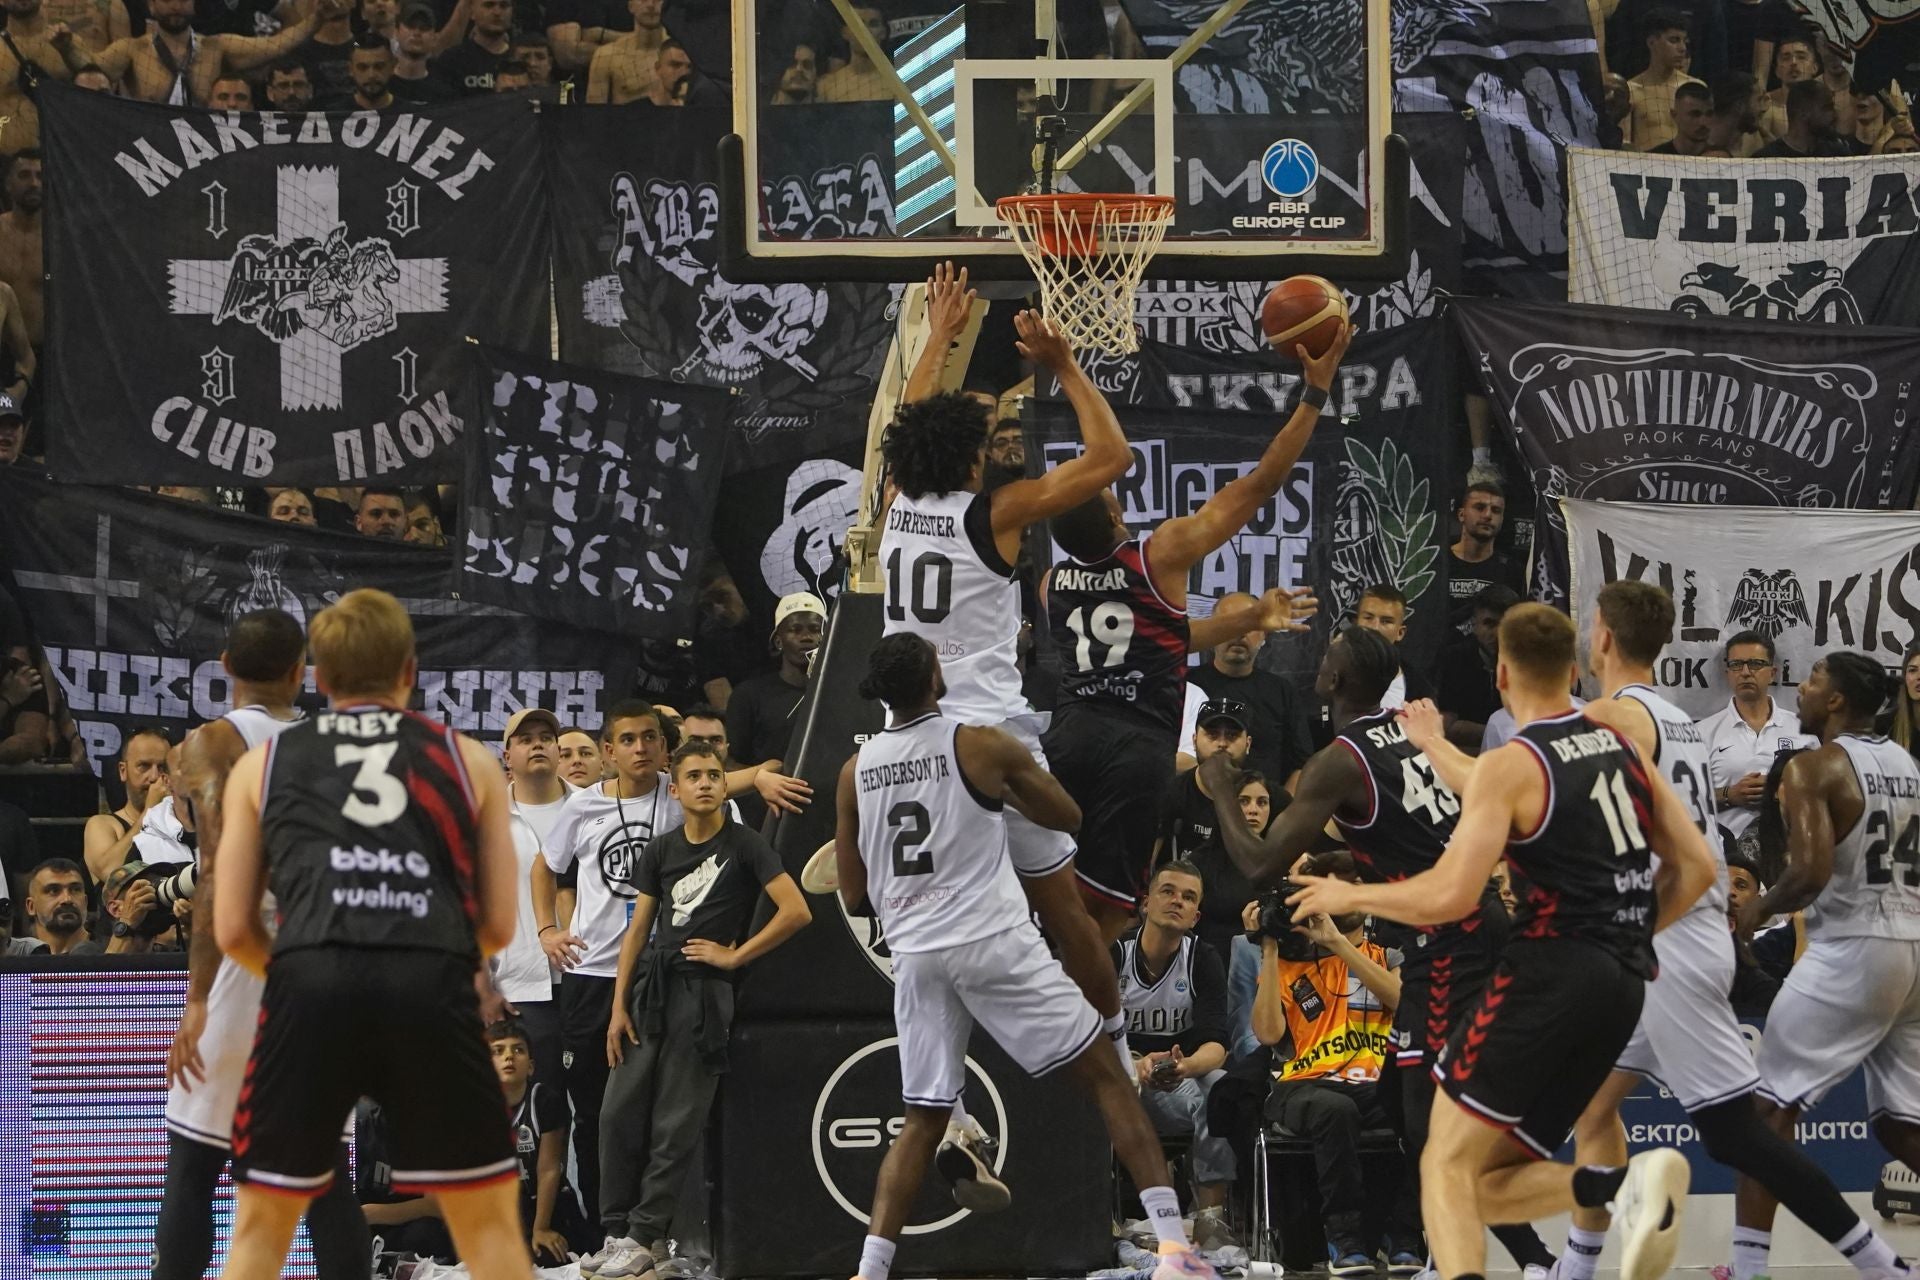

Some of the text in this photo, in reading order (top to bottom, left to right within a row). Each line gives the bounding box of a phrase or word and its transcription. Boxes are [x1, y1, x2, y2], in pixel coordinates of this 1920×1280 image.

[114, 110, 495, 201] ΜΑΚΕΔΟΝΕΣ
[1232, 217, 1345, 229] EUROPE CUP
[1269, 203, 1310, 214] FIBA
[1167, 355, 1422, 417] ΣΚΥΡΑ
[1536, 369, 1853, 469] NORTHERNERS
[151, 396, 278, 478] CLUB
[332, 390, 465, 481] ΠΑΟΚ
[1623, 431, 1757, 458] PAOK FANS
[1637, 470, 1728, 504] Since
[886, 547, 953, 624] 10
[1066, 601, 1134, 673] 19
[317, 711, 402, 738] FREY
[334, 741, 408, 828] 3
[861, 754, 949, 793] HENDERSON JR
[1400, 752, 1460, 825] 43
[887, 800, 934, 877] 2
[1589, 768, 1647, 857] 11
[1865, 809, 1920, 888] 24
[332, 881, 429, 918] vueling
[1301, 995, 1320, 1012] FIBA
